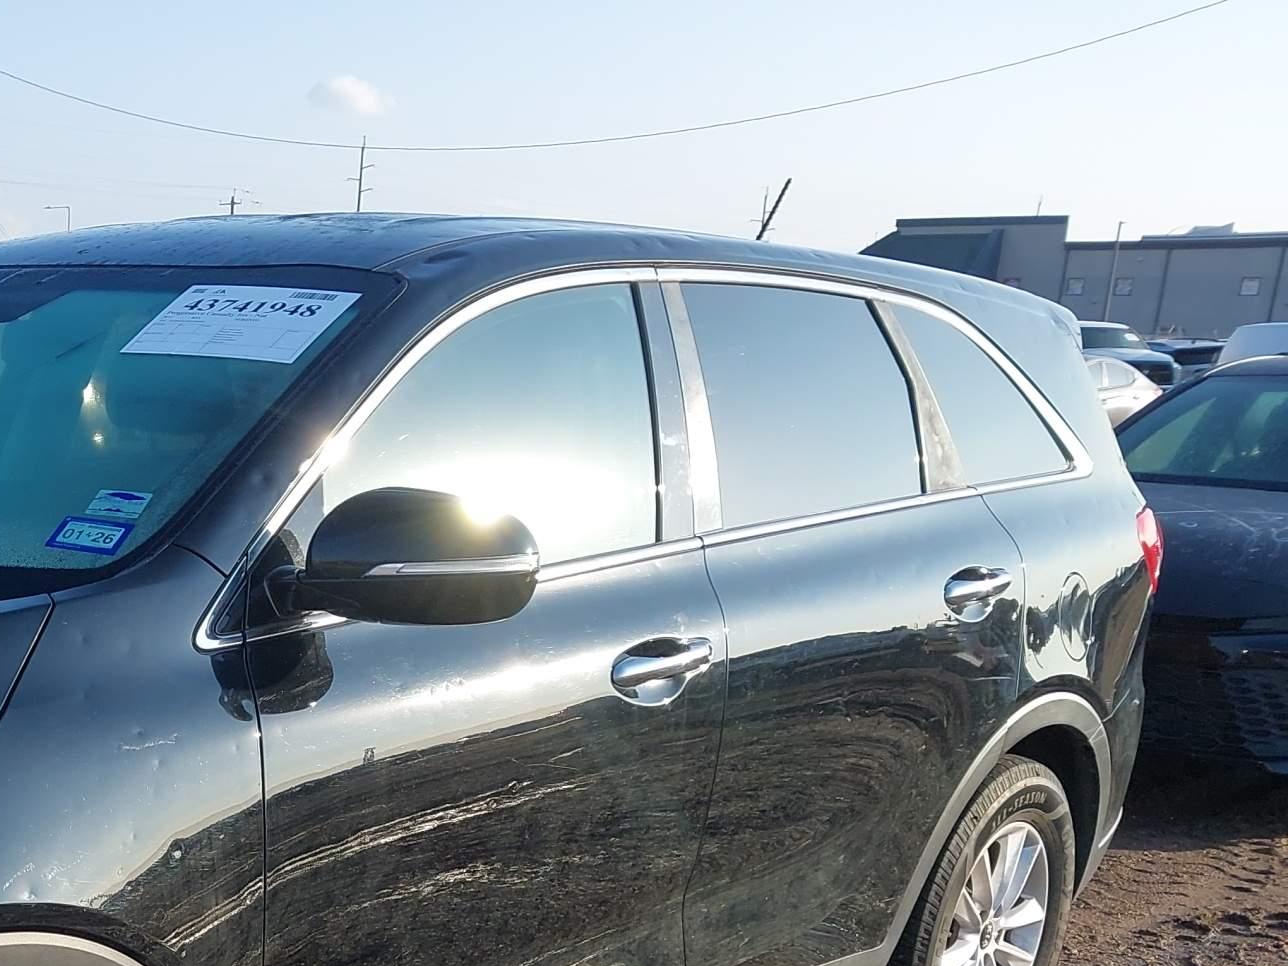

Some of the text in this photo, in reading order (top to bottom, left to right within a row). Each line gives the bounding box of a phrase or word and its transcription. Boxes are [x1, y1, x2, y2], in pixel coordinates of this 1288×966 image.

[184, 298, 322, 318] 43741948
[62, 528, 117, 545] 01 26
